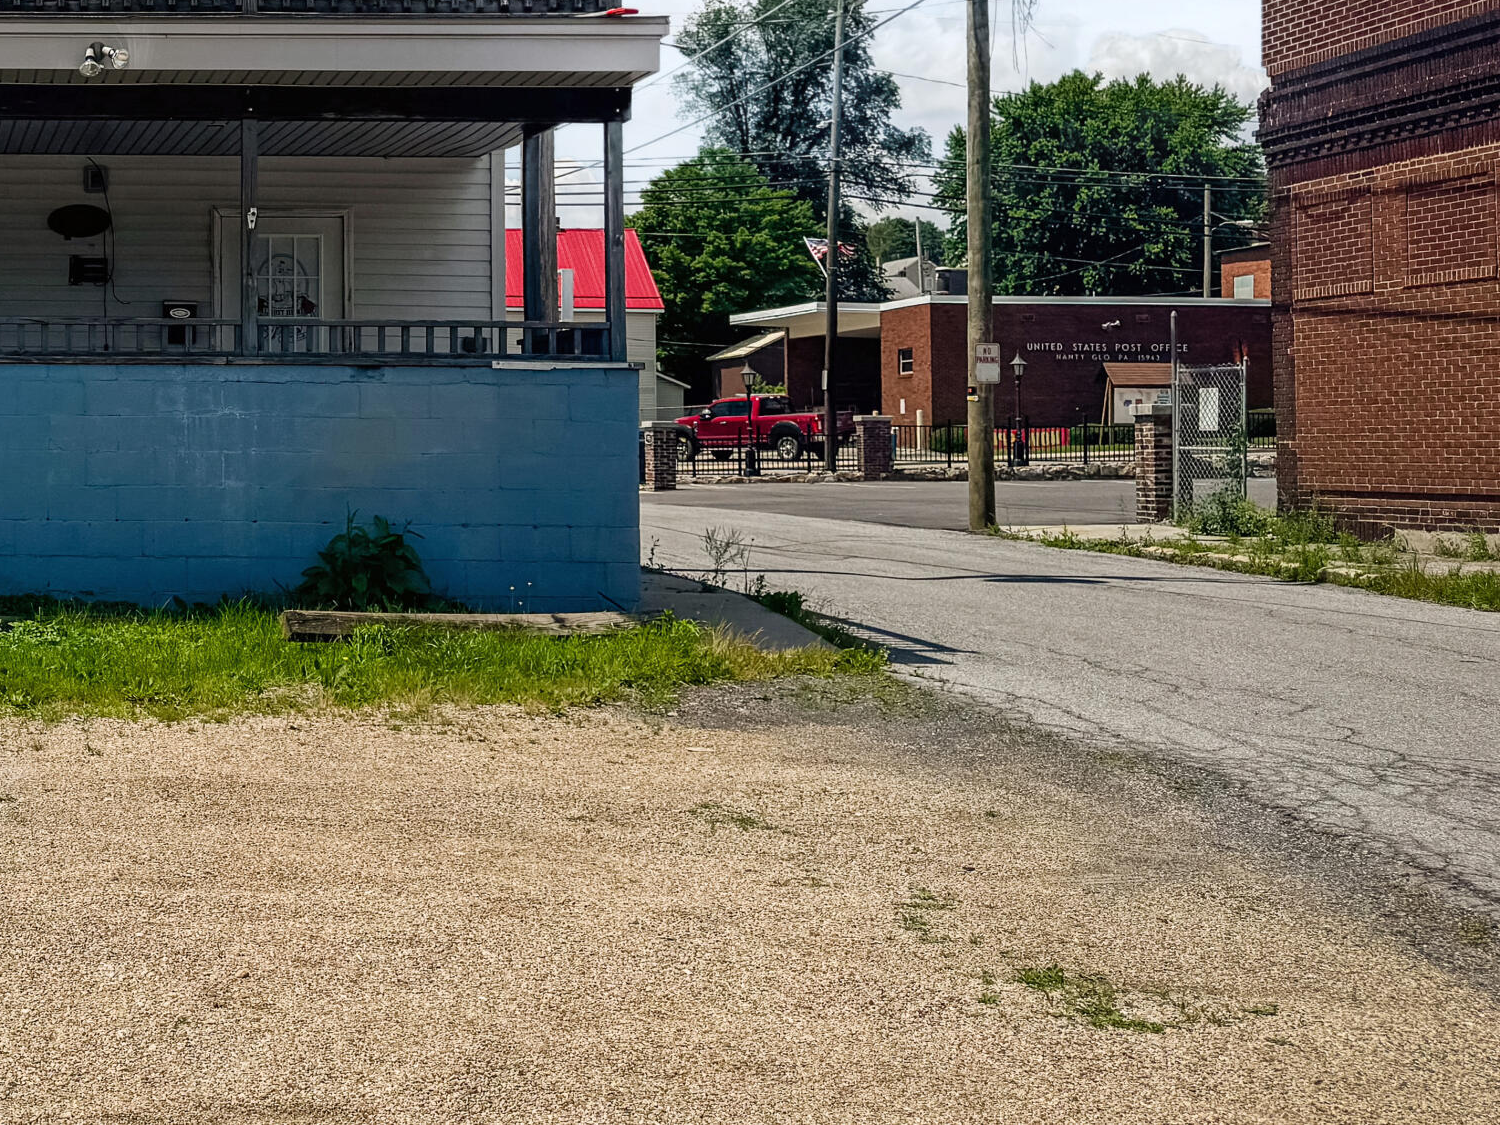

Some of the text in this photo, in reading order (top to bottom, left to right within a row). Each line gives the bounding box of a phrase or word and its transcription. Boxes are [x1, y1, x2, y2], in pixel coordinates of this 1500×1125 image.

[983, 347, 992, 355] NO
[1026, 343, 1189, 352] UNITED STATES POST OFFCE
[976, 356, 999, 364] PARKING
